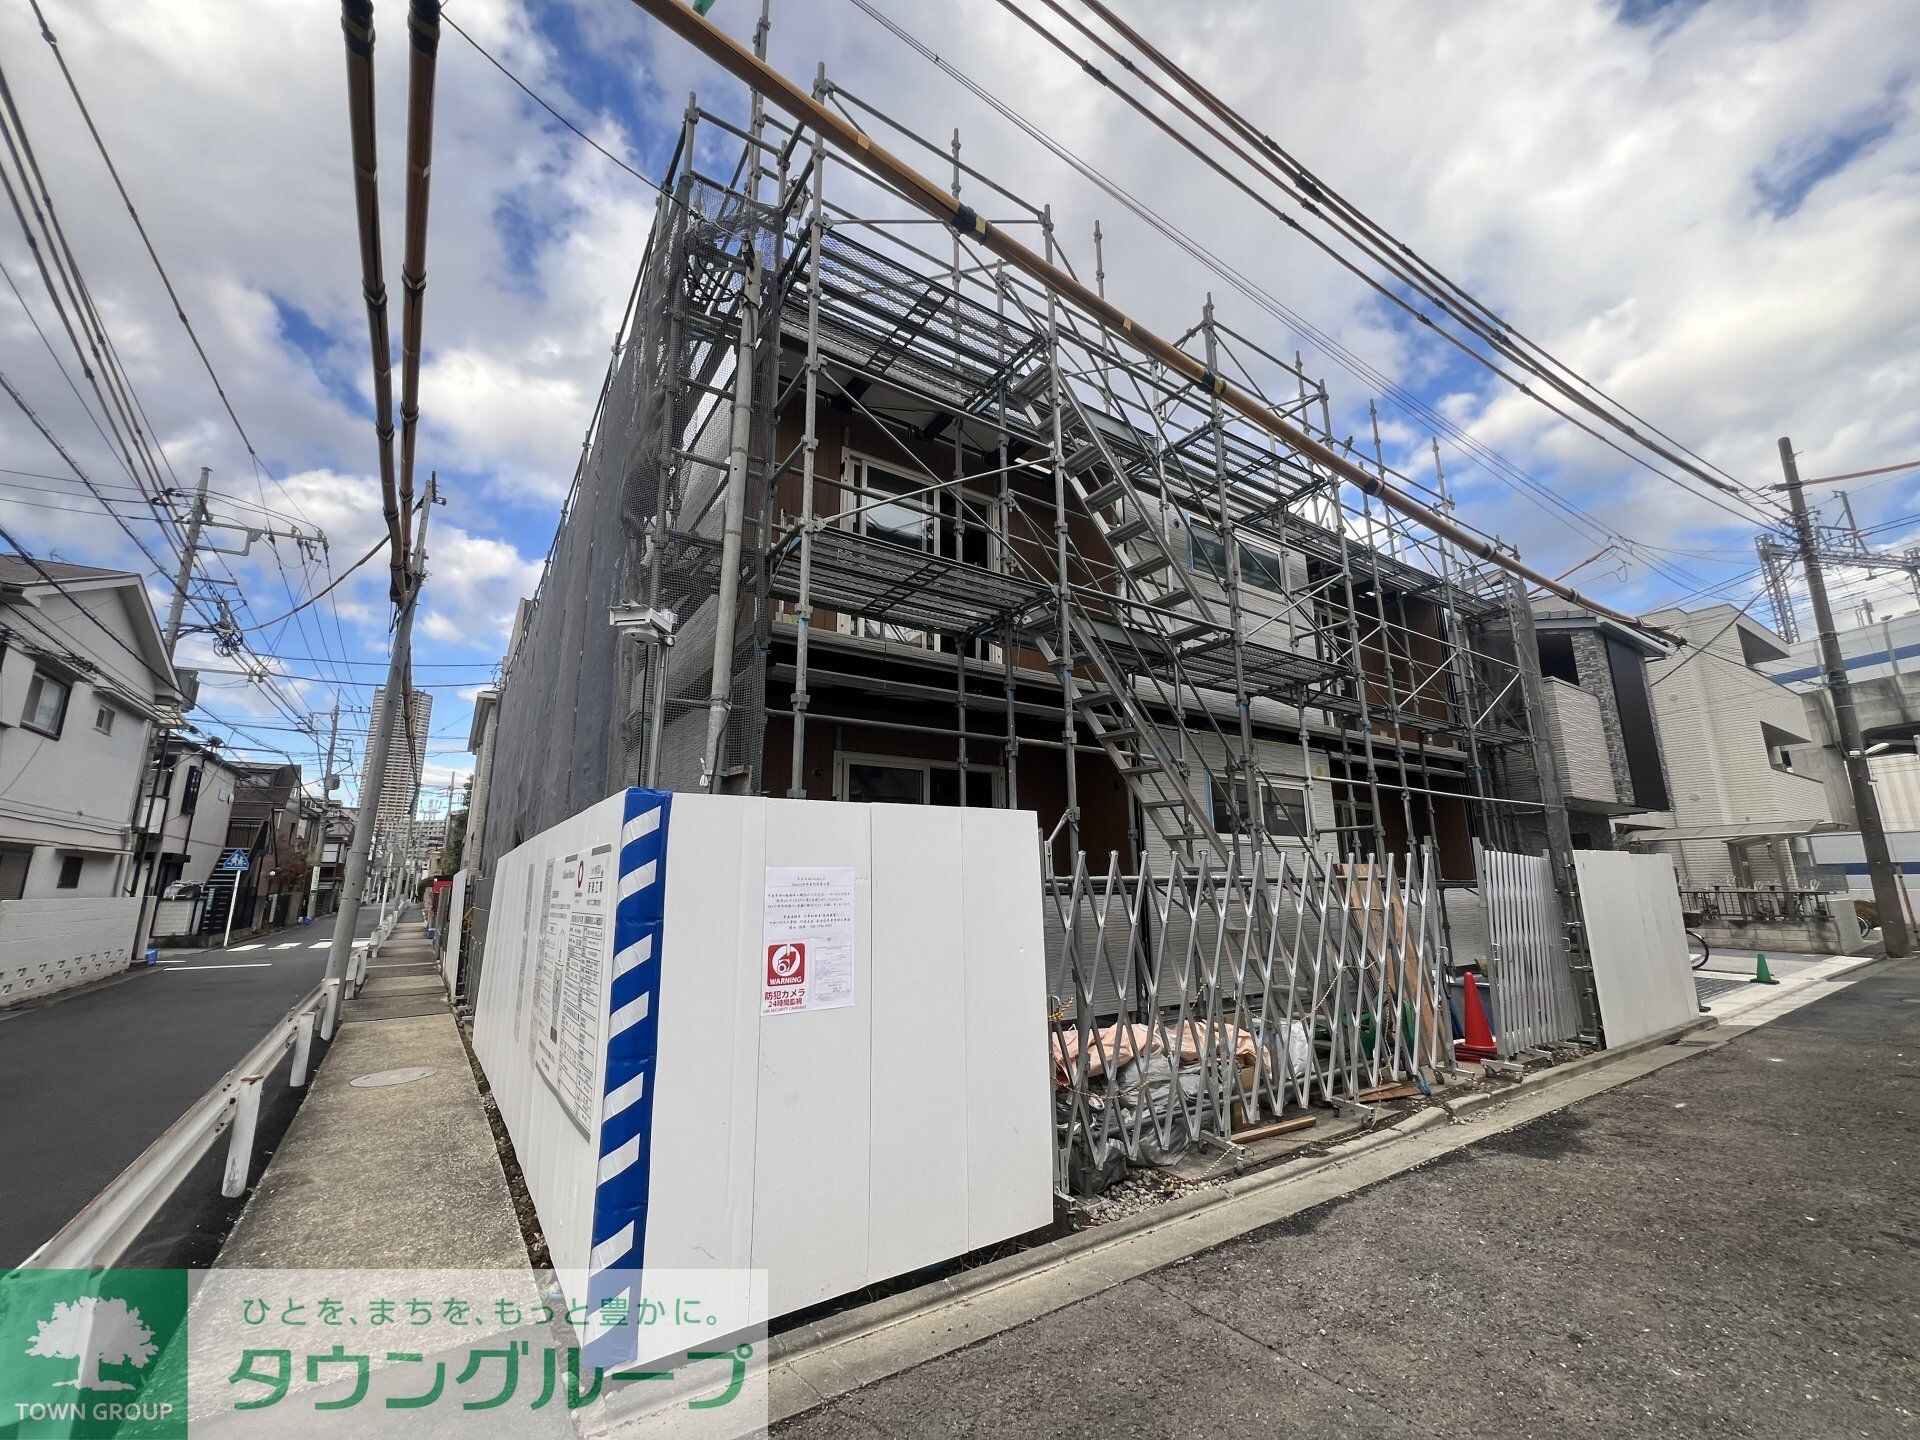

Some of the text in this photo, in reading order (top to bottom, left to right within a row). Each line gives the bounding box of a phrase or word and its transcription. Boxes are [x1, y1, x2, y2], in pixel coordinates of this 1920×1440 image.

[769, 976, 802, 985] WARNING
[764, 988, 806, 1001] 防犯カメラ
[768, 997, 803, 1008] 24時間監視
